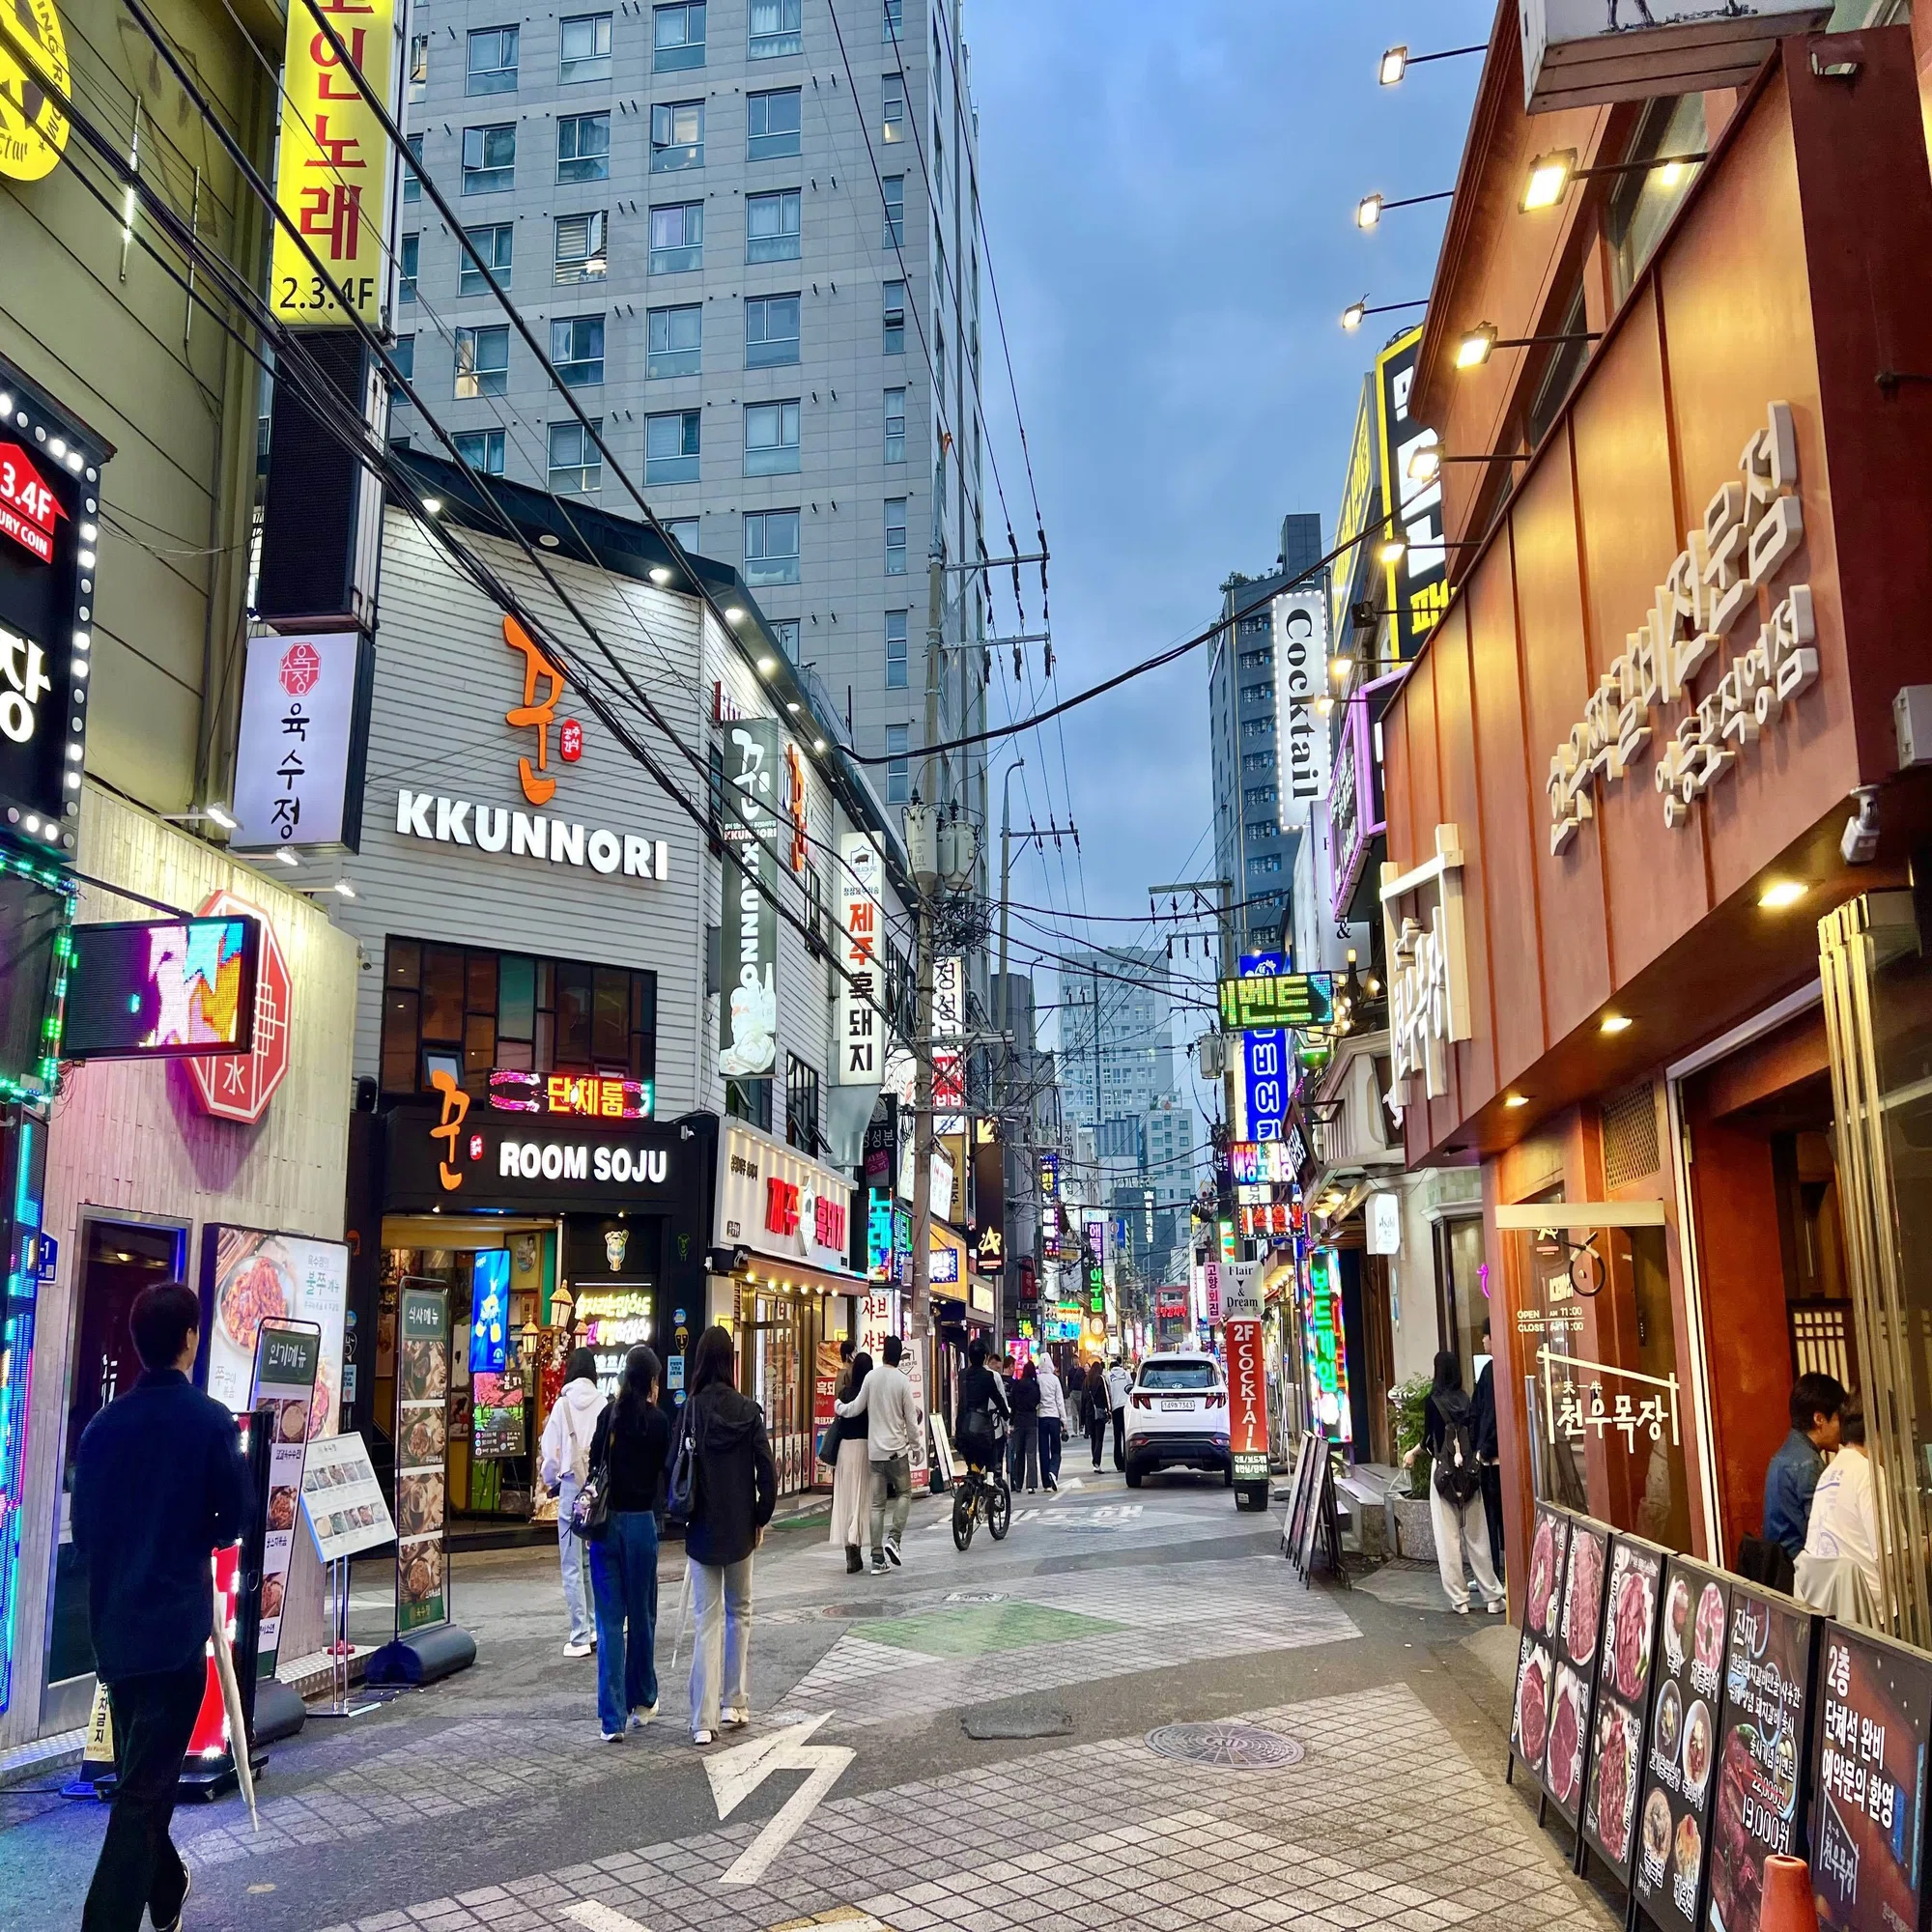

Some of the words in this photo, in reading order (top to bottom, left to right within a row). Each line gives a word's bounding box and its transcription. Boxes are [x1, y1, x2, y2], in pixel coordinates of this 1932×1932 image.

[279, 276, 375, 309] 2.3.4F
[20, 524, 48, 556] COIN
[1287, 608, 1319, 800] Cocktail
[270, 702, 310, 839] 육수정
[396, 788, 668, 881] KKUNNORI
[724, 827, 778, 840] KKUNORI
[849, 902, 874, 1072] 제주흑돼지
[547, 1076, 624, 1117] 단체룸
[499, 1141, 586, 1179] ROOM
[594, 1145, 667, 1183] SOJU
[1207, 1260, 1219, 1317] 고향회집
[1229, 1265, 1254, 1276] Flair
[862, 1293, 889, 1322] 샤브
[1227, 1296, 1258, 1308] Dream
[1237, 1287, 1245, 1297] &
[1518, 1310, 1540, 1320] OPEN
[1560, 1306, 1582, 1317] 11:00
[409, 1305, 439, 1325] 식사메뉴
[1234, 1324, 1254, 1342] 2F
[1518, 1322, 1545, 1332] CLOSE
[269, 1344, 307, 1368] 인기메뉴
[816, 1381, 835, 1396] 흑돼
[1237, 1344, 1259, 1452] COCKTAIL
[1556, 1394, 1669, 1454] 천우목장
[1733, 1608, 1759, 1654] 진짜
[1828, 1646, 1851, 1697] 2층
[1742, 1689, 1755, 1714] 양념
[1755, 1697, 1780, 1731] 돼지갈비
[1781, 1709, 1795, 1739] 출시
[1780, 1681, 1803, 1709] 사용한
[1825, 1699, 1858, 1754] 단체석
[1861, 1717, 1886, 1770] 완비
[1749, 1732, 1775, 1770] 출시기념
[1775, 1753, 1795, 1782] 이벤트
[1822, 1748, 1867, 1812] 예약문의
[1868, 1774, 1894, 1829] 환영
[1742, 1794, 1790, 1855] 19,000원
[1823, 1835, 1854, 1902] 천우목장
